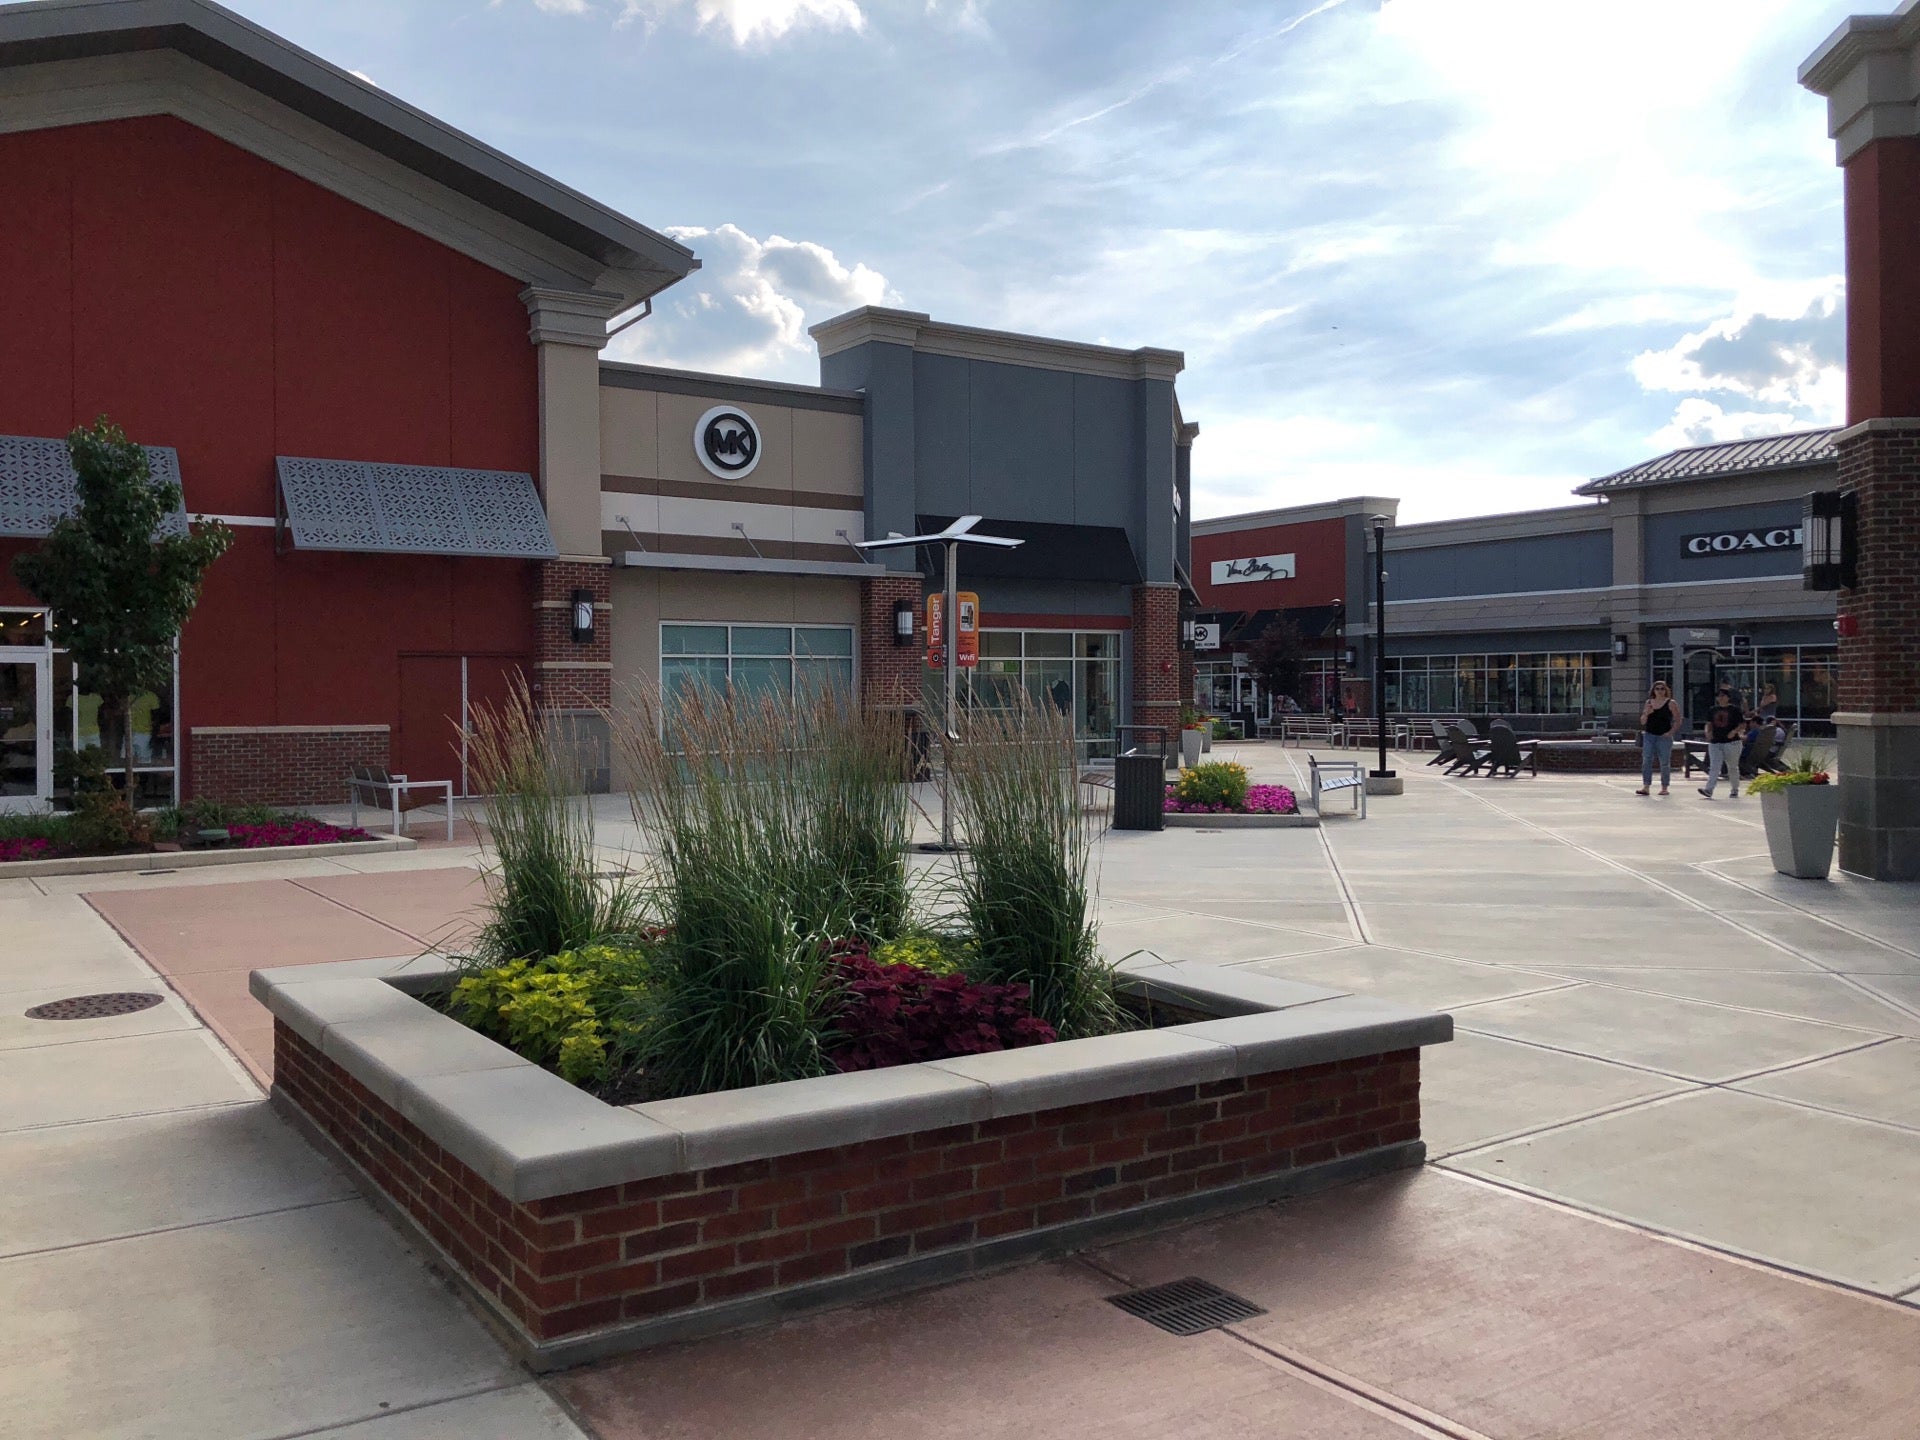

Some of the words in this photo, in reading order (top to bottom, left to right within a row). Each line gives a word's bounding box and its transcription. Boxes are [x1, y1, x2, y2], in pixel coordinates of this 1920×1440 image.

[711, 428, 751, 456] MK
[931, 597, 942, 644] Tanger
[959, 653, 975, 661] Wifi
